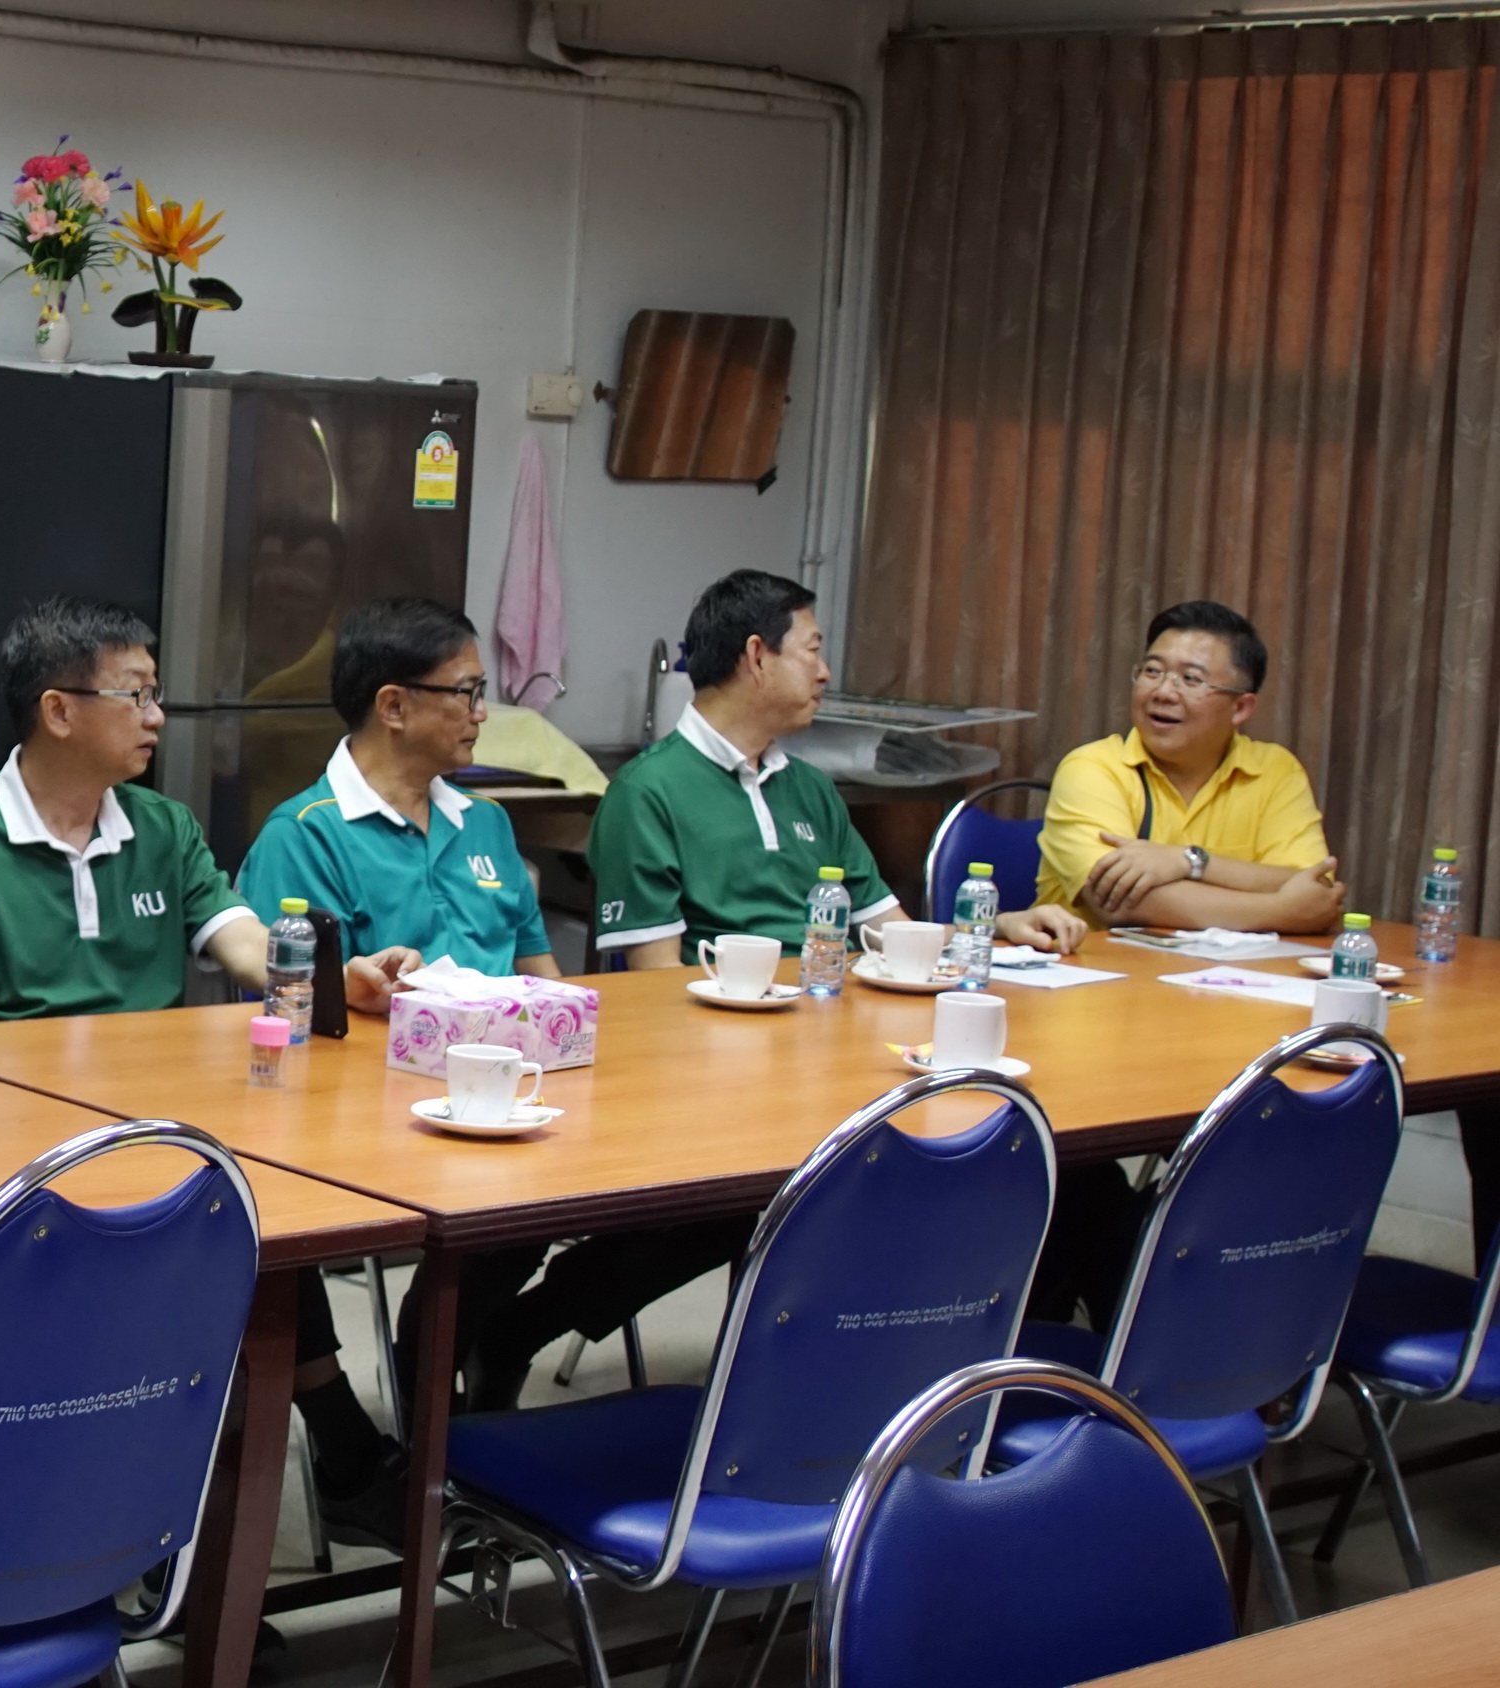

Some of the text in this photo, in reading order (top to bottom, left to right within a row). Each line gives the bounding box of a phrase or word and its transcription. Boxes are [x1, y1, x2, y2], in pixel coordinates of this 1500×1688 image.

[792, 820, 815, 842] KU
[467, 855, 497, 880] KU
[131, 890, 166, 917] KU
[973, 903, 997, 921] KU
[810, 906, 837, 925] KU
